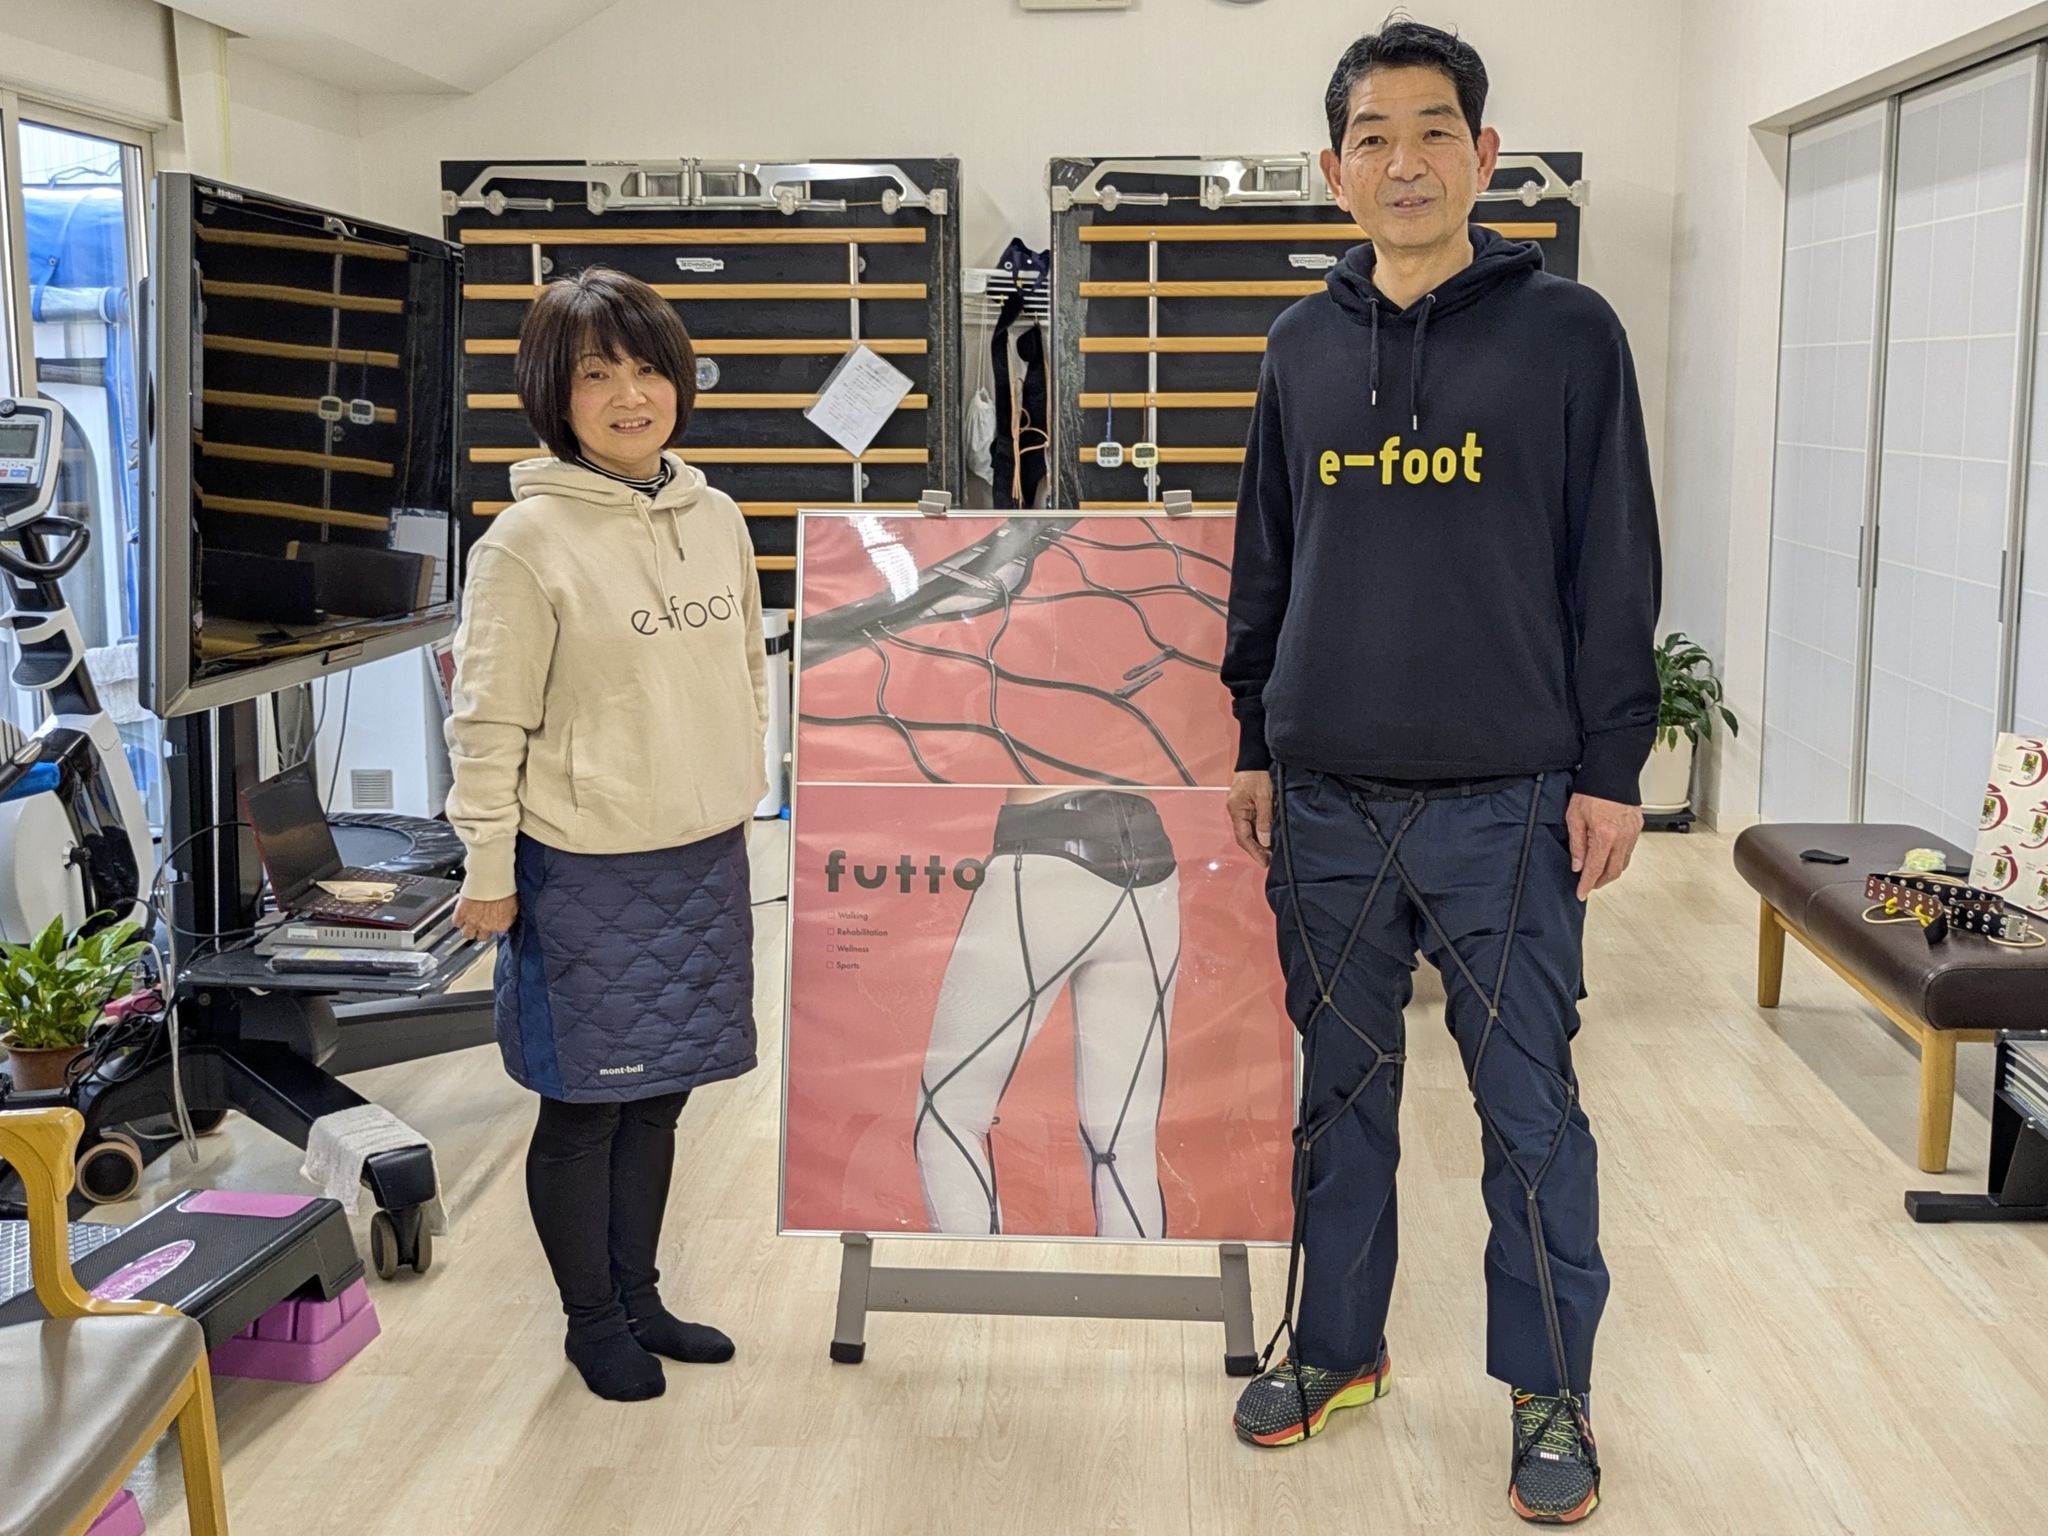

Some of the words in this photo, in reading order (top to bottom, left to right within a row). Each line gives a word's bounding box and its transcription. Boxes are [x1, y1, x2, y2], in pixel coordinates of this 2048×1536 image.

[1320, 432, 1482, 486] e-foot
[630, 585, 740, 635] e-foot
[825, 849, 986, 894] futto
[838, 911, 869, 922] Walking
[837, 928, 889, 937] Rehabilitation
[836, 944, 870, 953] Wellness
[836, 961, 860, 970] Sports
